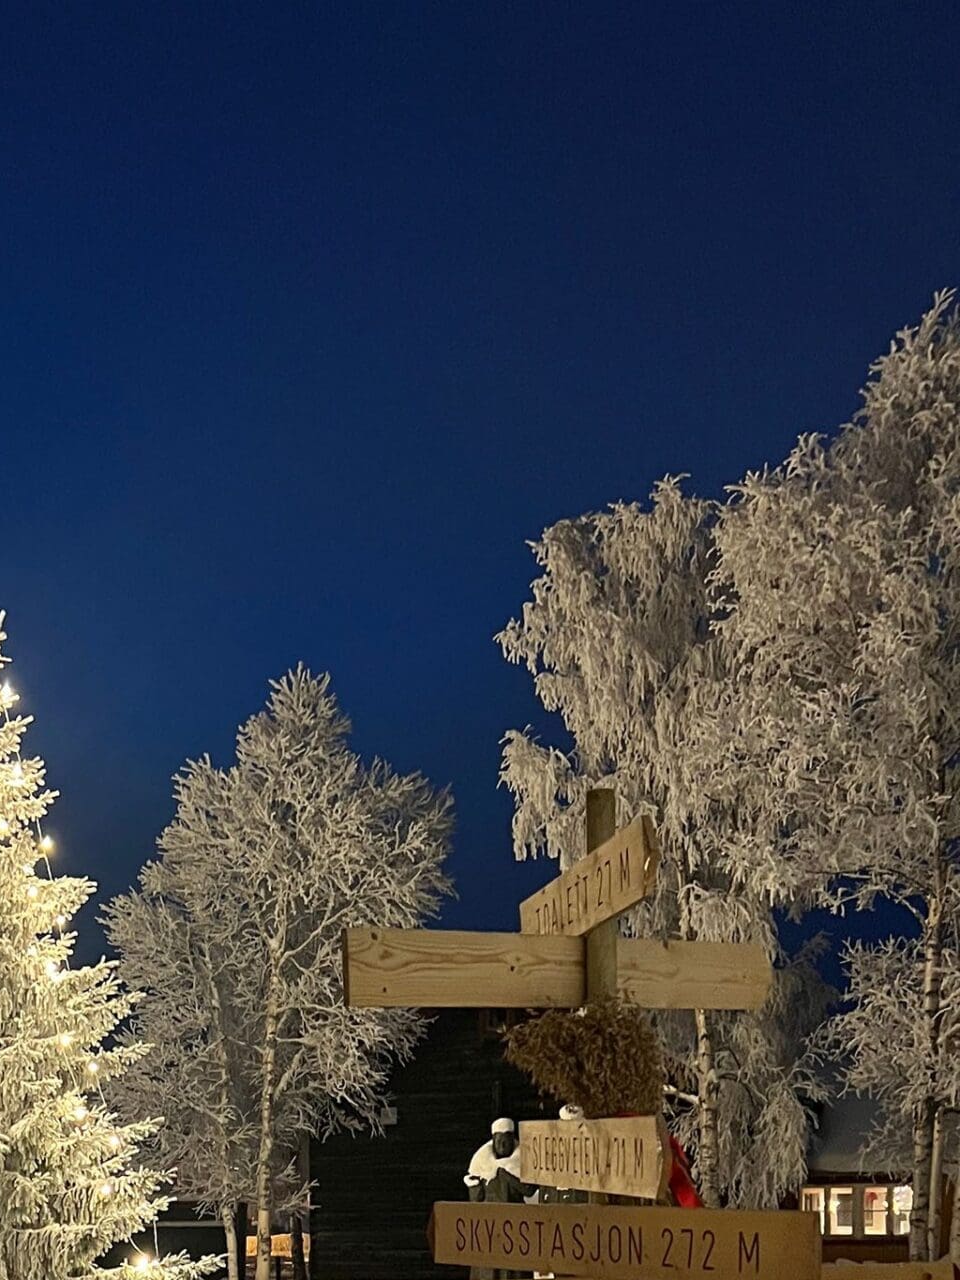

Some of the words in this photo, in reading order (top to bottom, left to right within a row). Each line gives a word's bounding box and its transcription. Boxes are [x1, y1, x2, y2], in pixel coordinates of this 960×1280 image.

[535, 875, 589, 934] TOALETT
[596, 860, 612, 907] 27
[619, 847, 631, 893] M
[532, 1134, 599, 1176] SLEGGVEIEN
[634, 1137, 644, 1179] M
[455, 1217, 642, 1265] SKYSSTASJON
[661, 1227, 716, 1272] 272
[739, 1231, 761, 1274] M
